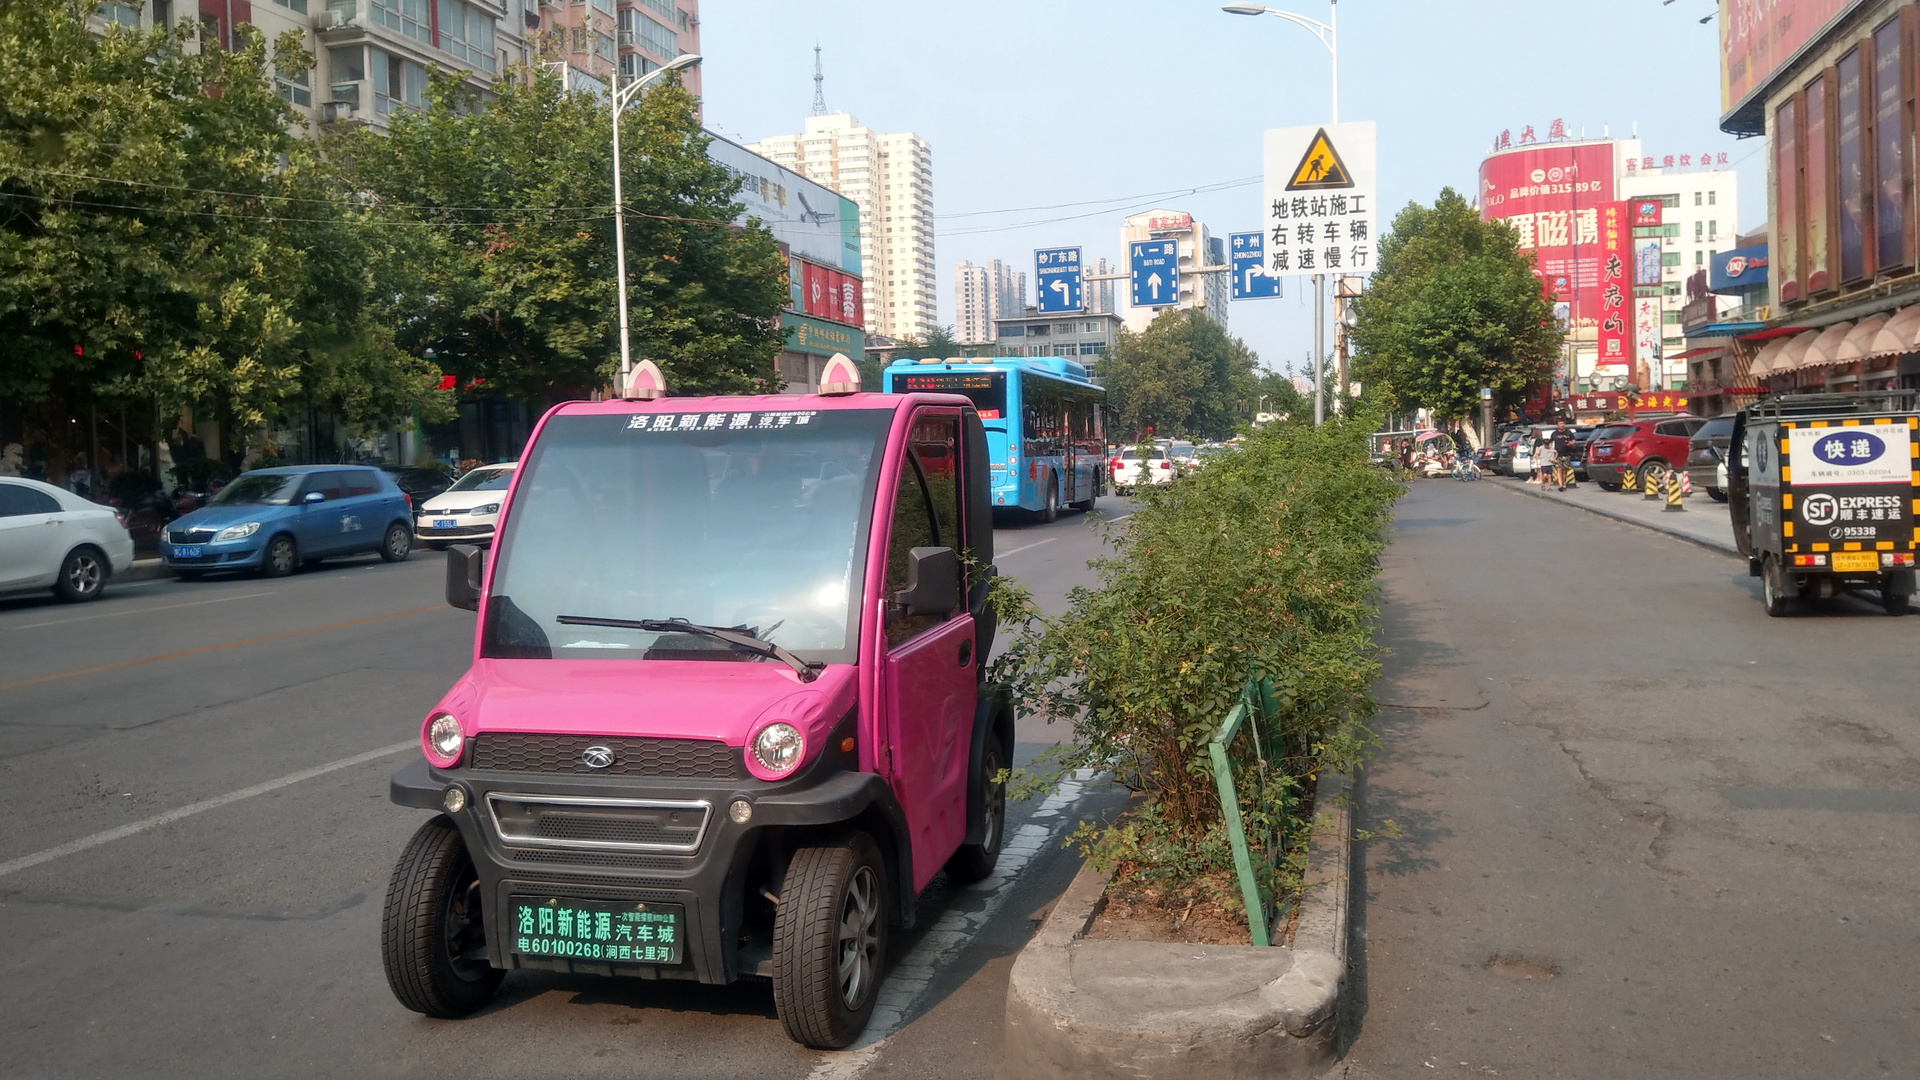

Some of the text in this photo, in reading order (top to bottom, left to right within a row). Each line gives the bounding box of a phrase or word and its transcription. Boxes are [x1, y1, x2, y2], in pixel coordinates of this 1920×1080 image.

[1626, 152, 1729, 171] 客房 餐饮 会议
[1272, 194, 1367, 220] 地铁站施工
[1271, 219, 1368, 246] 右转车辆
[1134, 243, 1174, 257] 八一路
[1233, 235, 1260, 249] 中州
[1039, 250, 1078, 264] 纱厂东路
[1272, 245, 1369, 272] 减速慢行
[1602, 253, 1624, 335] 老君山
[626, 413, 752, 429] 洛阳新能源
[1824, 438, 1872, 460] 快递
[1809, 502, 1832, 518] SF
[1839, 496, 1901, 509] EXPRESS
[1839, 508, 1902, 521] 顺丰速运
[1843, 526, 1877, 536] 95338
[518, 905, 612, 941] 洛阳新能源
[615, 924, 675, 943] 汽车城
